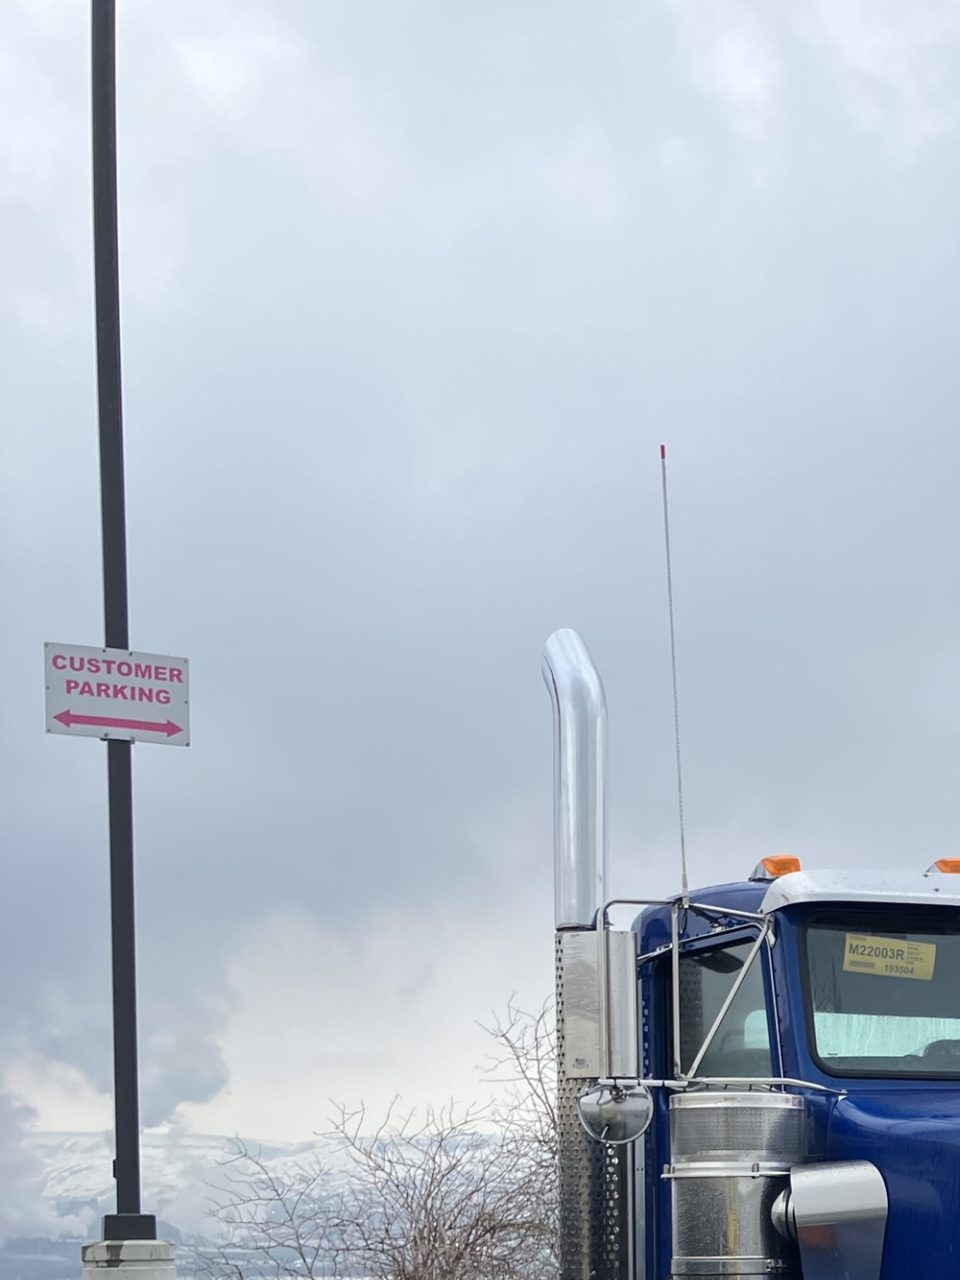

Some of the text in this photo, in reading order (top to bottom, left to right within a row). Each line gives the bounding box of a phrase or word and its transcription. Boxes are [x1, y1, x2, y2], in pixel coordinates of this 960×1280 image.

[52, 655, 183, 683] CUSTOMER
[65, 679, 171, 704] PARKING
[848, 943, 905, 960] M22003R
